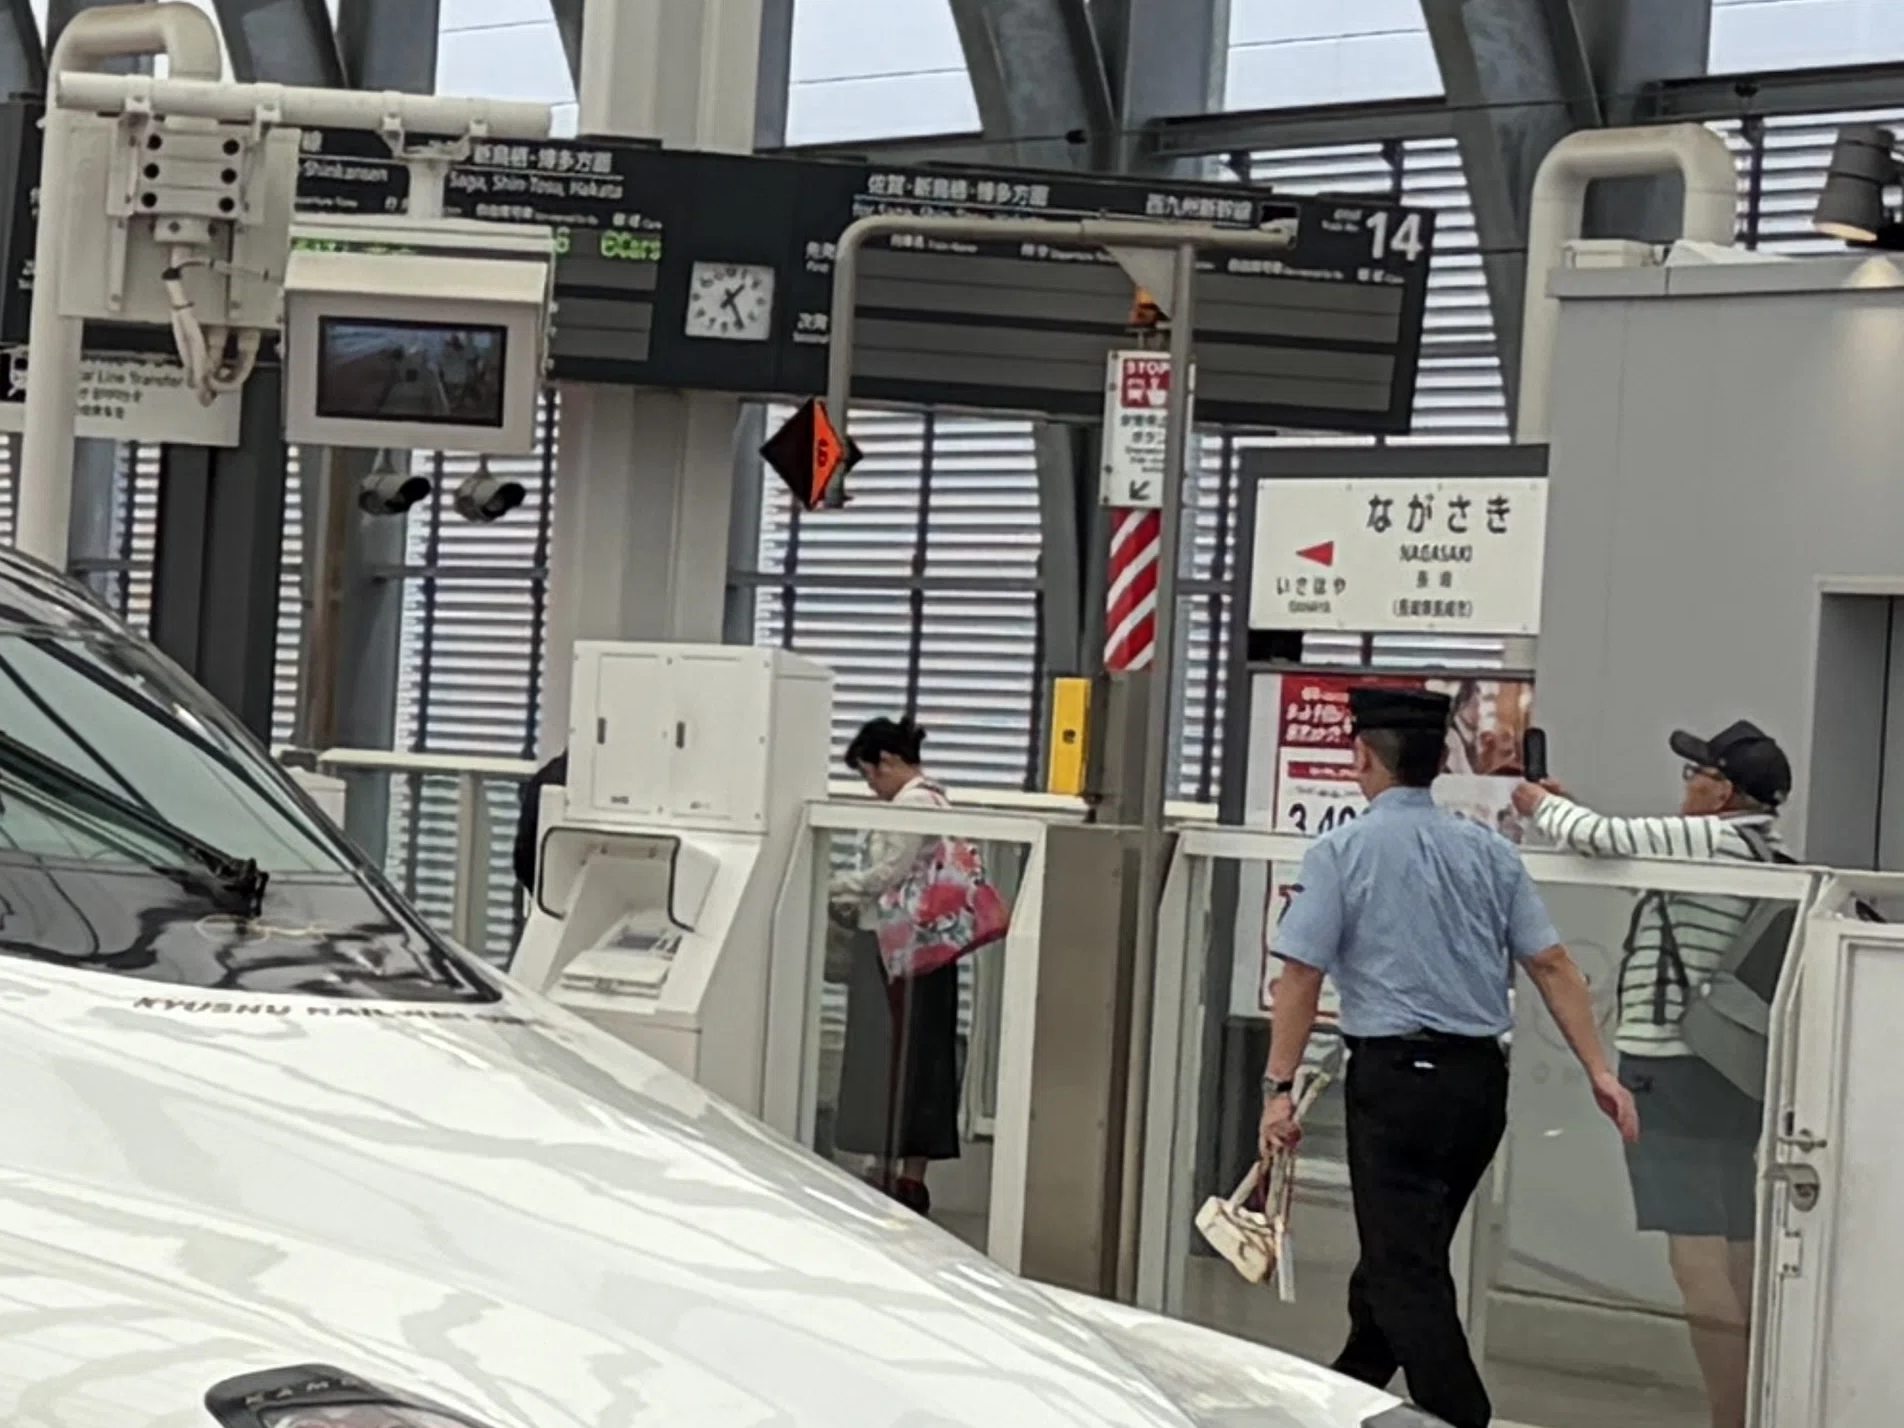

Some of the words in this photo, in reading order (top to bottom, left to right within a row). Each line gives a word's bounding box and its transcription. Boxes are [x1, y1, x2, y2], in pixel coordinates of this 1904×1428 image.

[1365, 210, 1423, 262] 14
[1366, 492, 1512, 534] ながさき
[1399, 543, 1473, 563] NAGASAKI
[1276, 576, 1347, 596] いさはや
